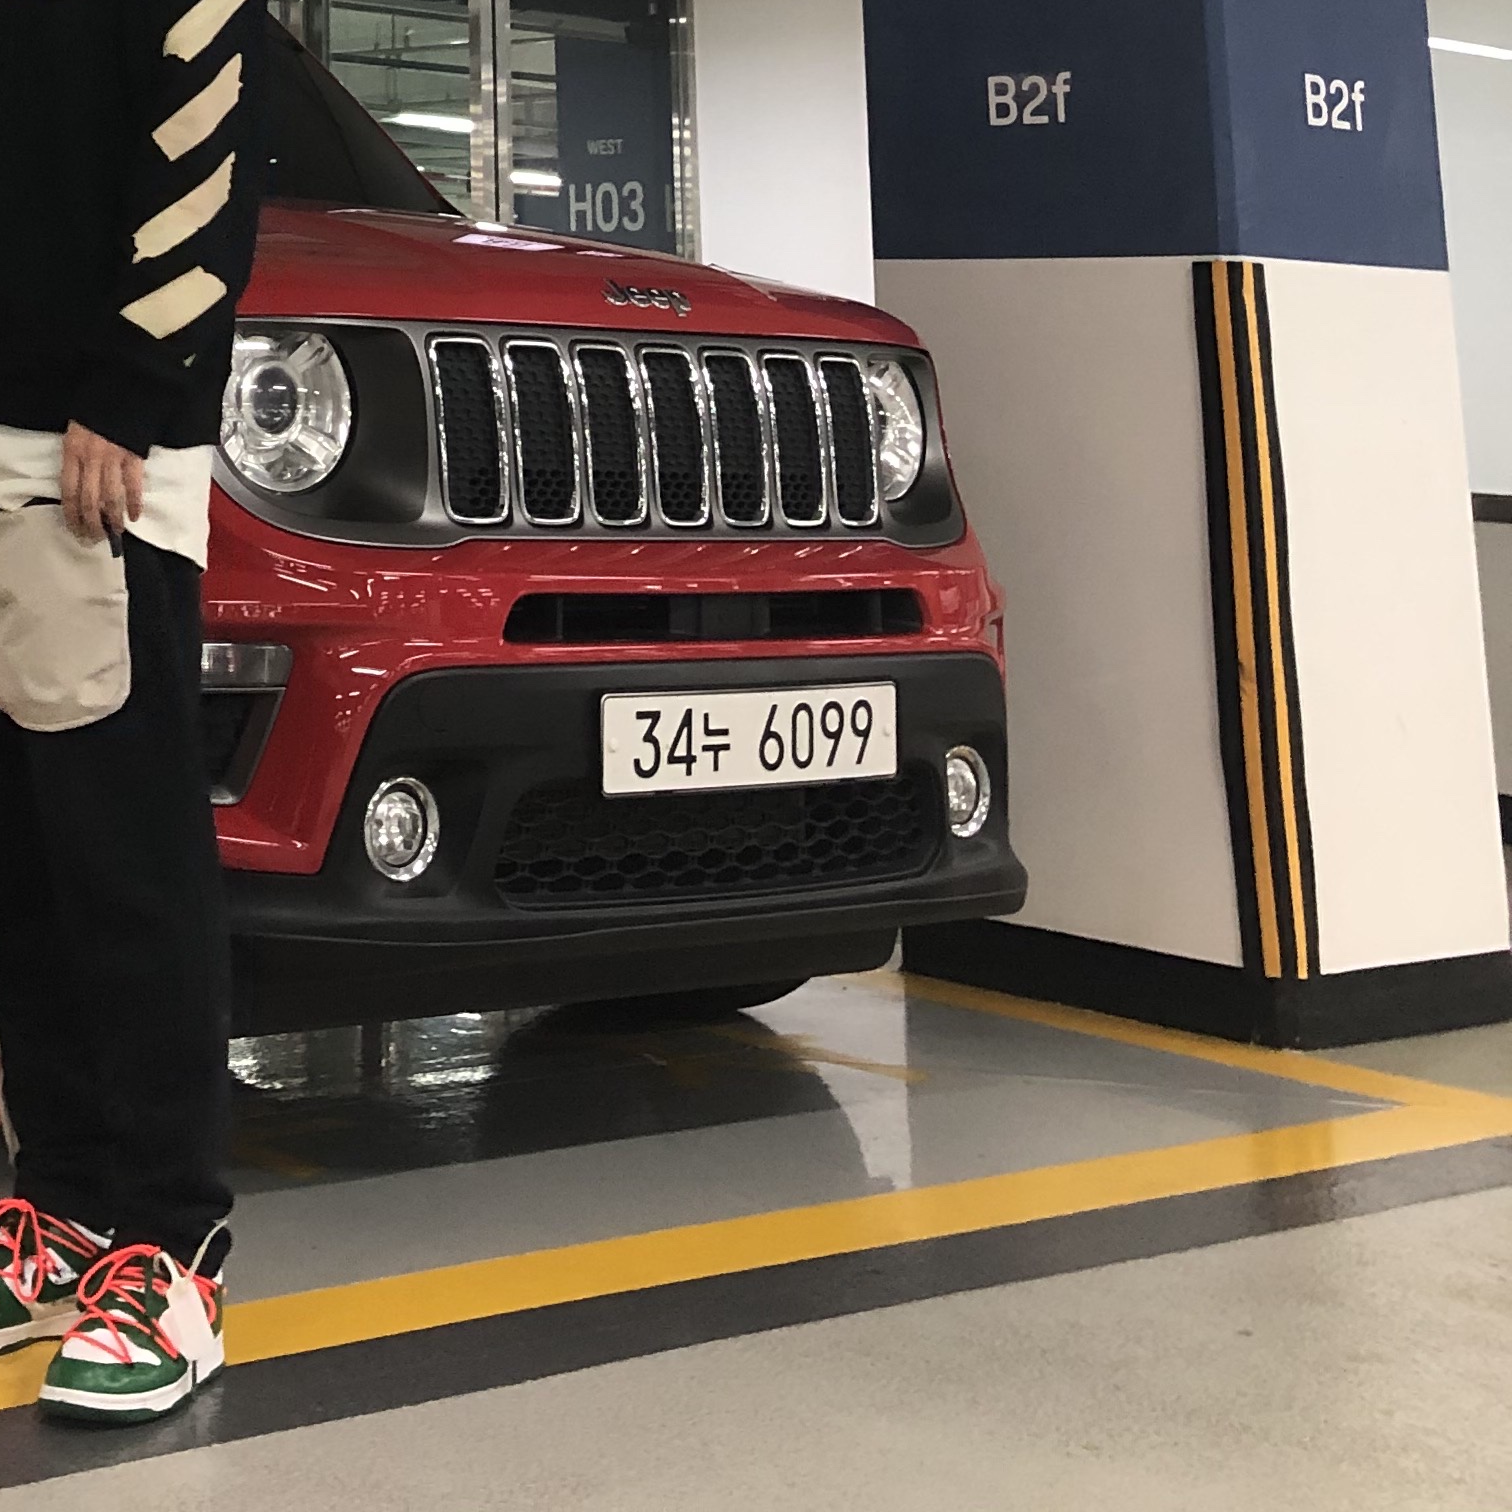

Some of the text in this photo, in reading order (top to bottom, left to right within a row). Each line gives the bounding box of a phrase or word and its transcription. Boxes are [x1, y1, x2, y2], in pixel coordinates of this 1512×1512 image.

[986, 70, 1072, 127] B2f
[1303, 73, 1367, 132] B2f
[587, 138, 623, 155] WEST
[569, 180, 645, 233] H03
[601, 277, 692, 318] Jeep
[633, 699, 874, 779] 34누 6099
